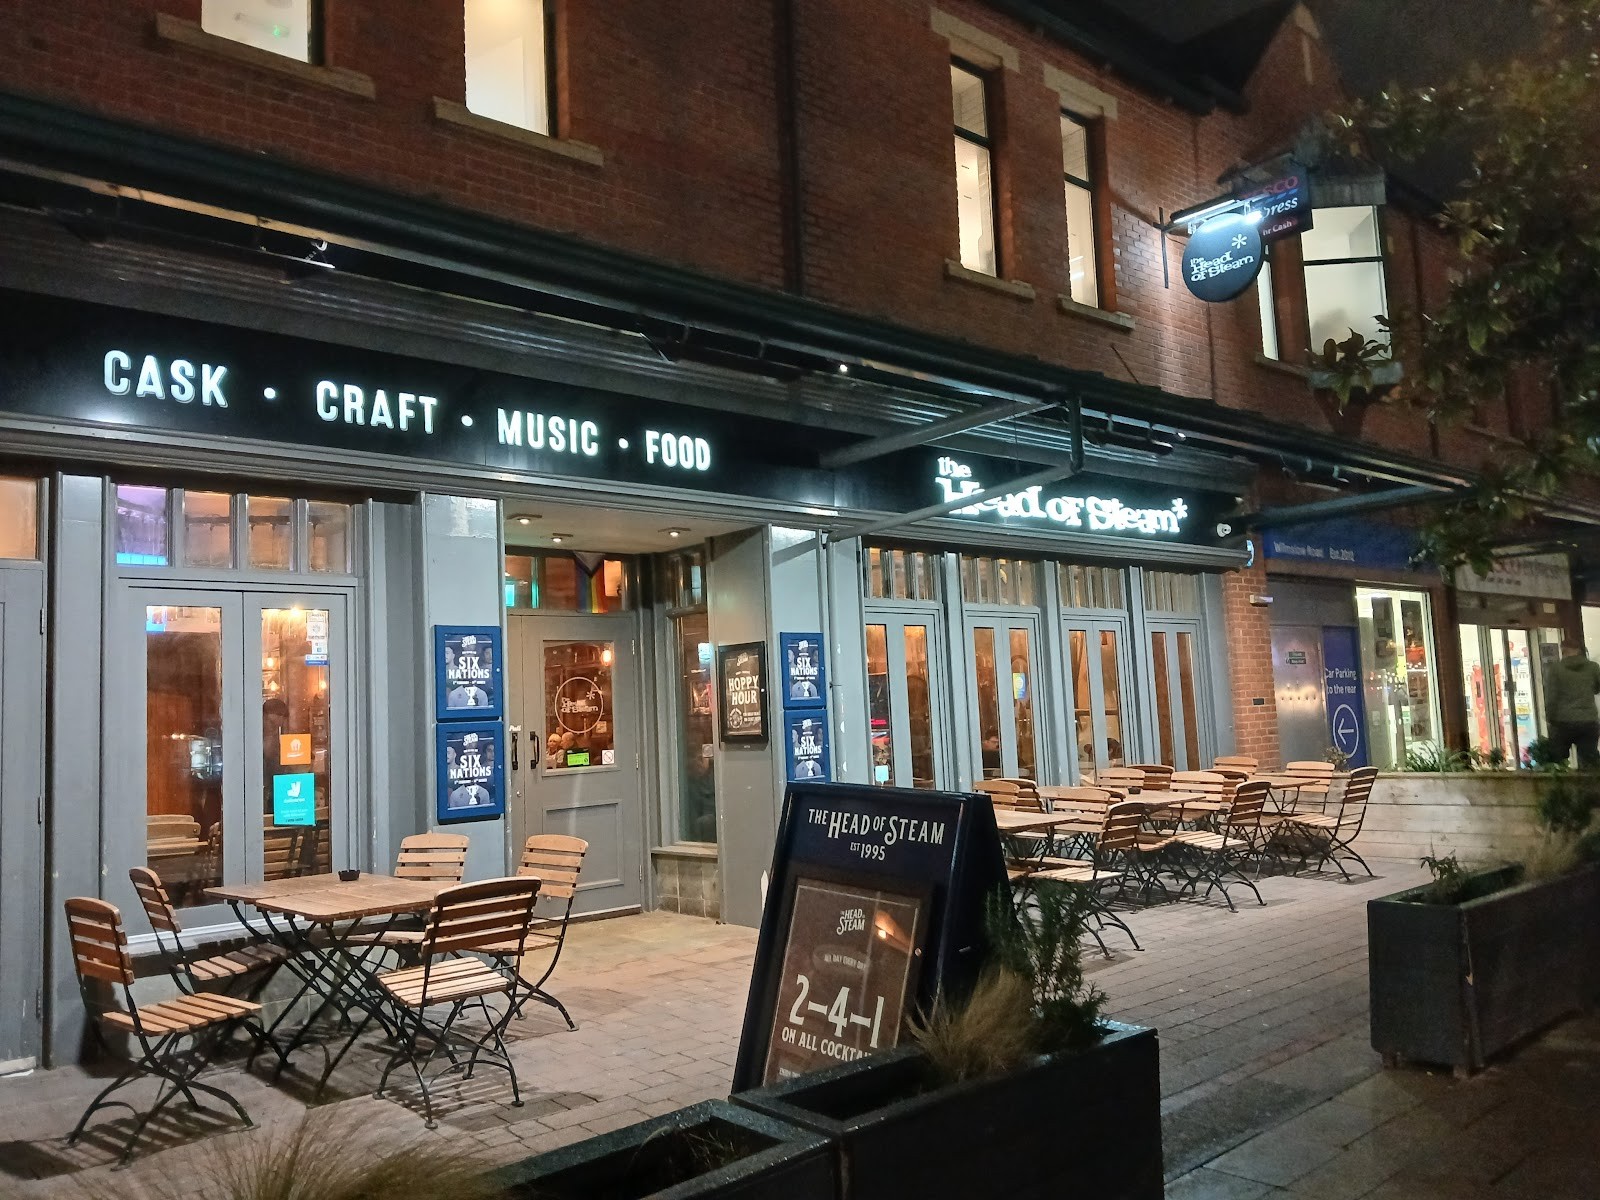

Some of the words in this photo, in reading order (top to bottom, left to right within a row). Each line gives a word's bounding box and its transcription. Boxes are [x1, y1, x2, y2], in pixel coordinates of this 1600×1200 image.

[1272, 220, 1292, 232] Cash
[1190, 270, 1207, 281] of
[1207, 255, 1254, 278] Steam
[1191, 250, 1233, 275] Head
[104, 350, 228, 408] CASK
[316, 380, 438, 435] CRAFT
[497, 407, 600, 457] MUSIC
[645, 430, 711, 471] FOOD
[937, 456, 973, 478] the
[1045, 496, 1085, 526] of
[1085, 496, 1181, 534] Steam
[458, 656, 480, 670] SIX
[796, 656, 811, 668] SIX
[448, 668, 490, 679] NATIONS
[790, 666, 818, 676] NATIONS
[1335, 668, 1357, 680] Parking
[728, 675, 759, 692] HOPPY
[1334, 684, 1344, 694] the
[1345, 686, 1357, 694] rear
[731, 690, 758, 705] HOUR
[801, 736, 815, 748] SIX
[794, 745, 822, 756] NATIONS
[460, 754, 481, 769] SIX
[450, 766, 492, 779] NATIONS
[808, 808, 829, 825] THE
[827, 811, 871, 839] HEAD
[872, 816, 887, 832] OF
[884, 816, 945, 845] STEAM
[850, 842, 860, 851] EST
[860, 843, 886, 861] 1995
[844, 908, 863, 920] HEAD
[836, 916, 866, 936] STEAM
[789, 974, 885, 1049] 2-4-1
[781, 1026, 796, 1044] ON
[798, 1031, 818, 1052] ALL
[820, 1038, 872, 1062] COCKTA
